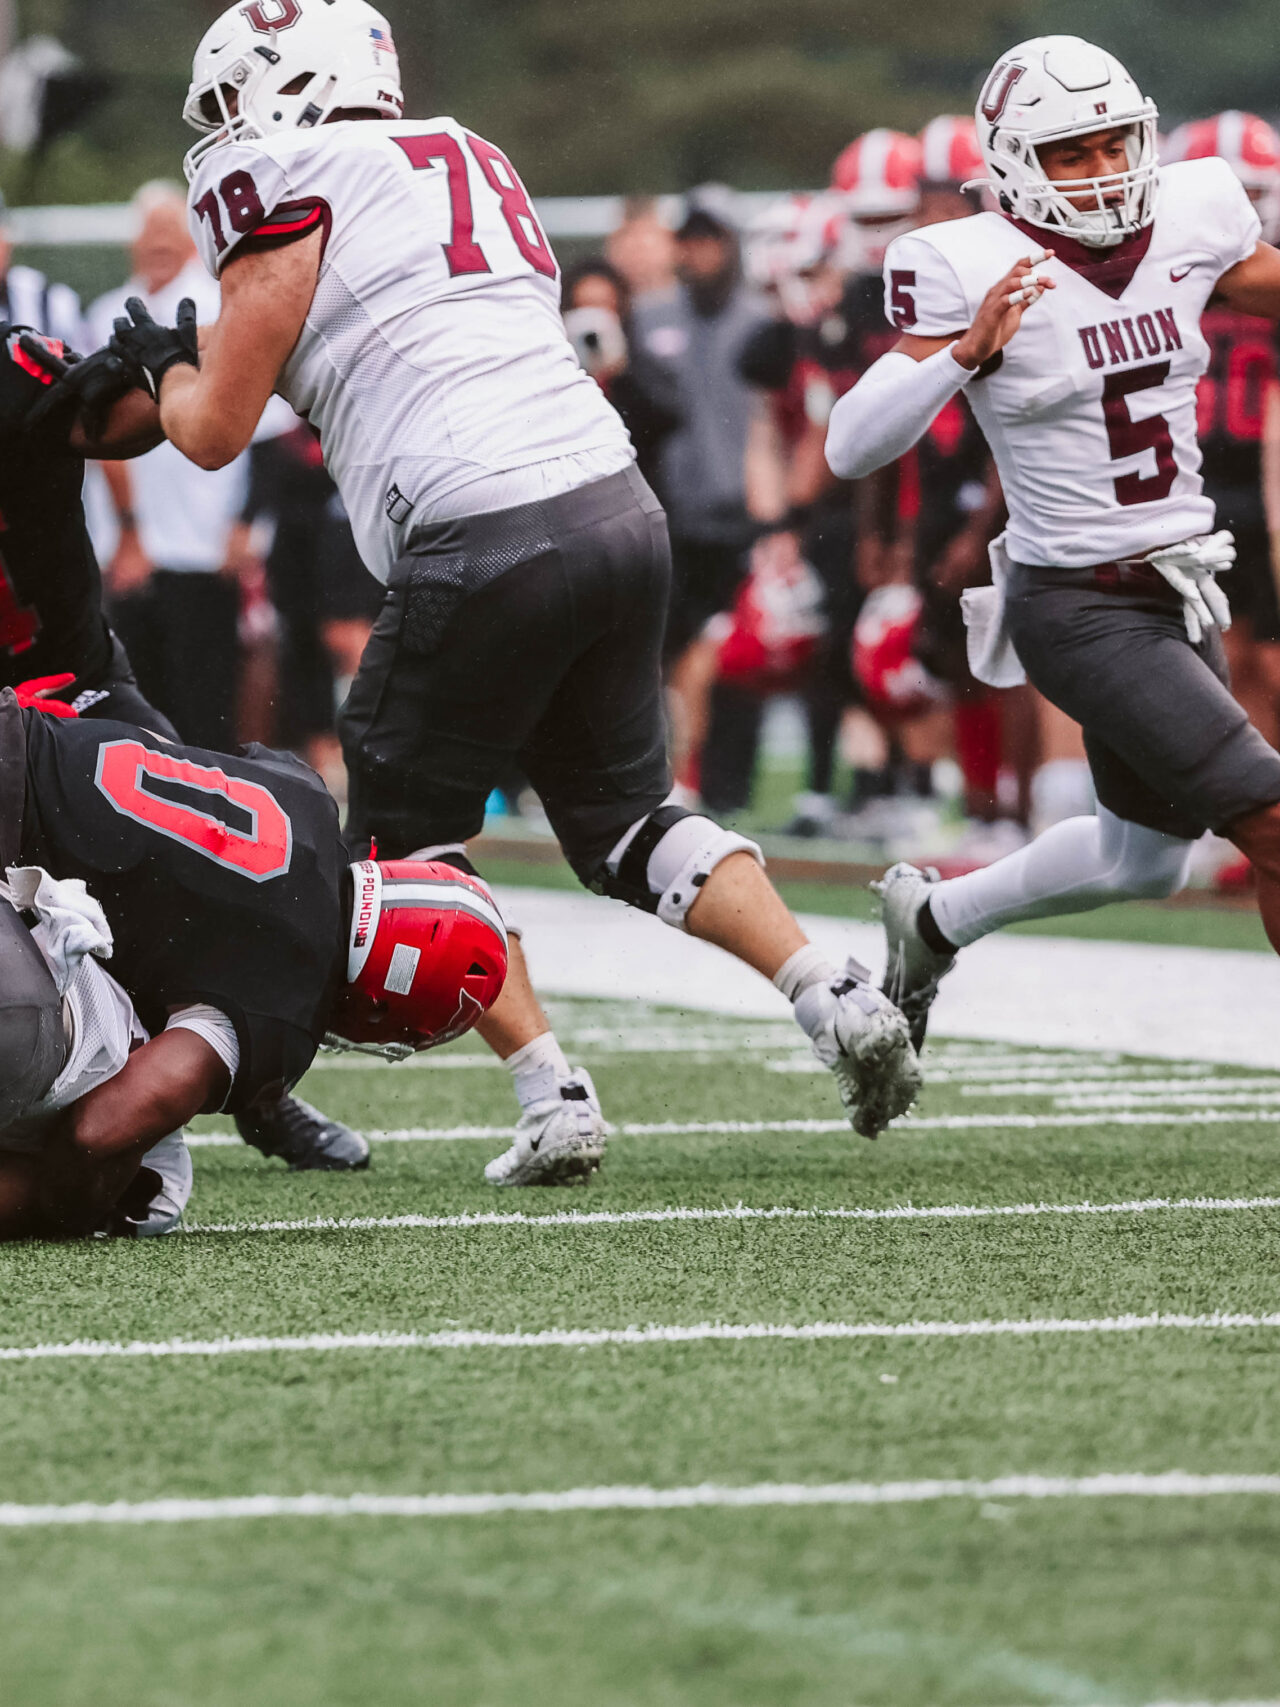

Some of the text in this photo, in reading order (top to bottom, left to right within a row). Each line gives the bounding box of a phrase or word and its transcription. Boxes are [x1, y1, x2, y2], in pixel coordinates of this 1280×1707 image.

[239, 0, 303, 35] U
[981, 62, 1028, 126] U
[192, 169, 266, 256] 78
[391, 132, 557, 280] 78
[889, 269, 919, 330] 5
[1078, 307, 1183, 370] UNION
[1101, 359, 1179, 506] 5
[94, 739, 292, 883] 0
